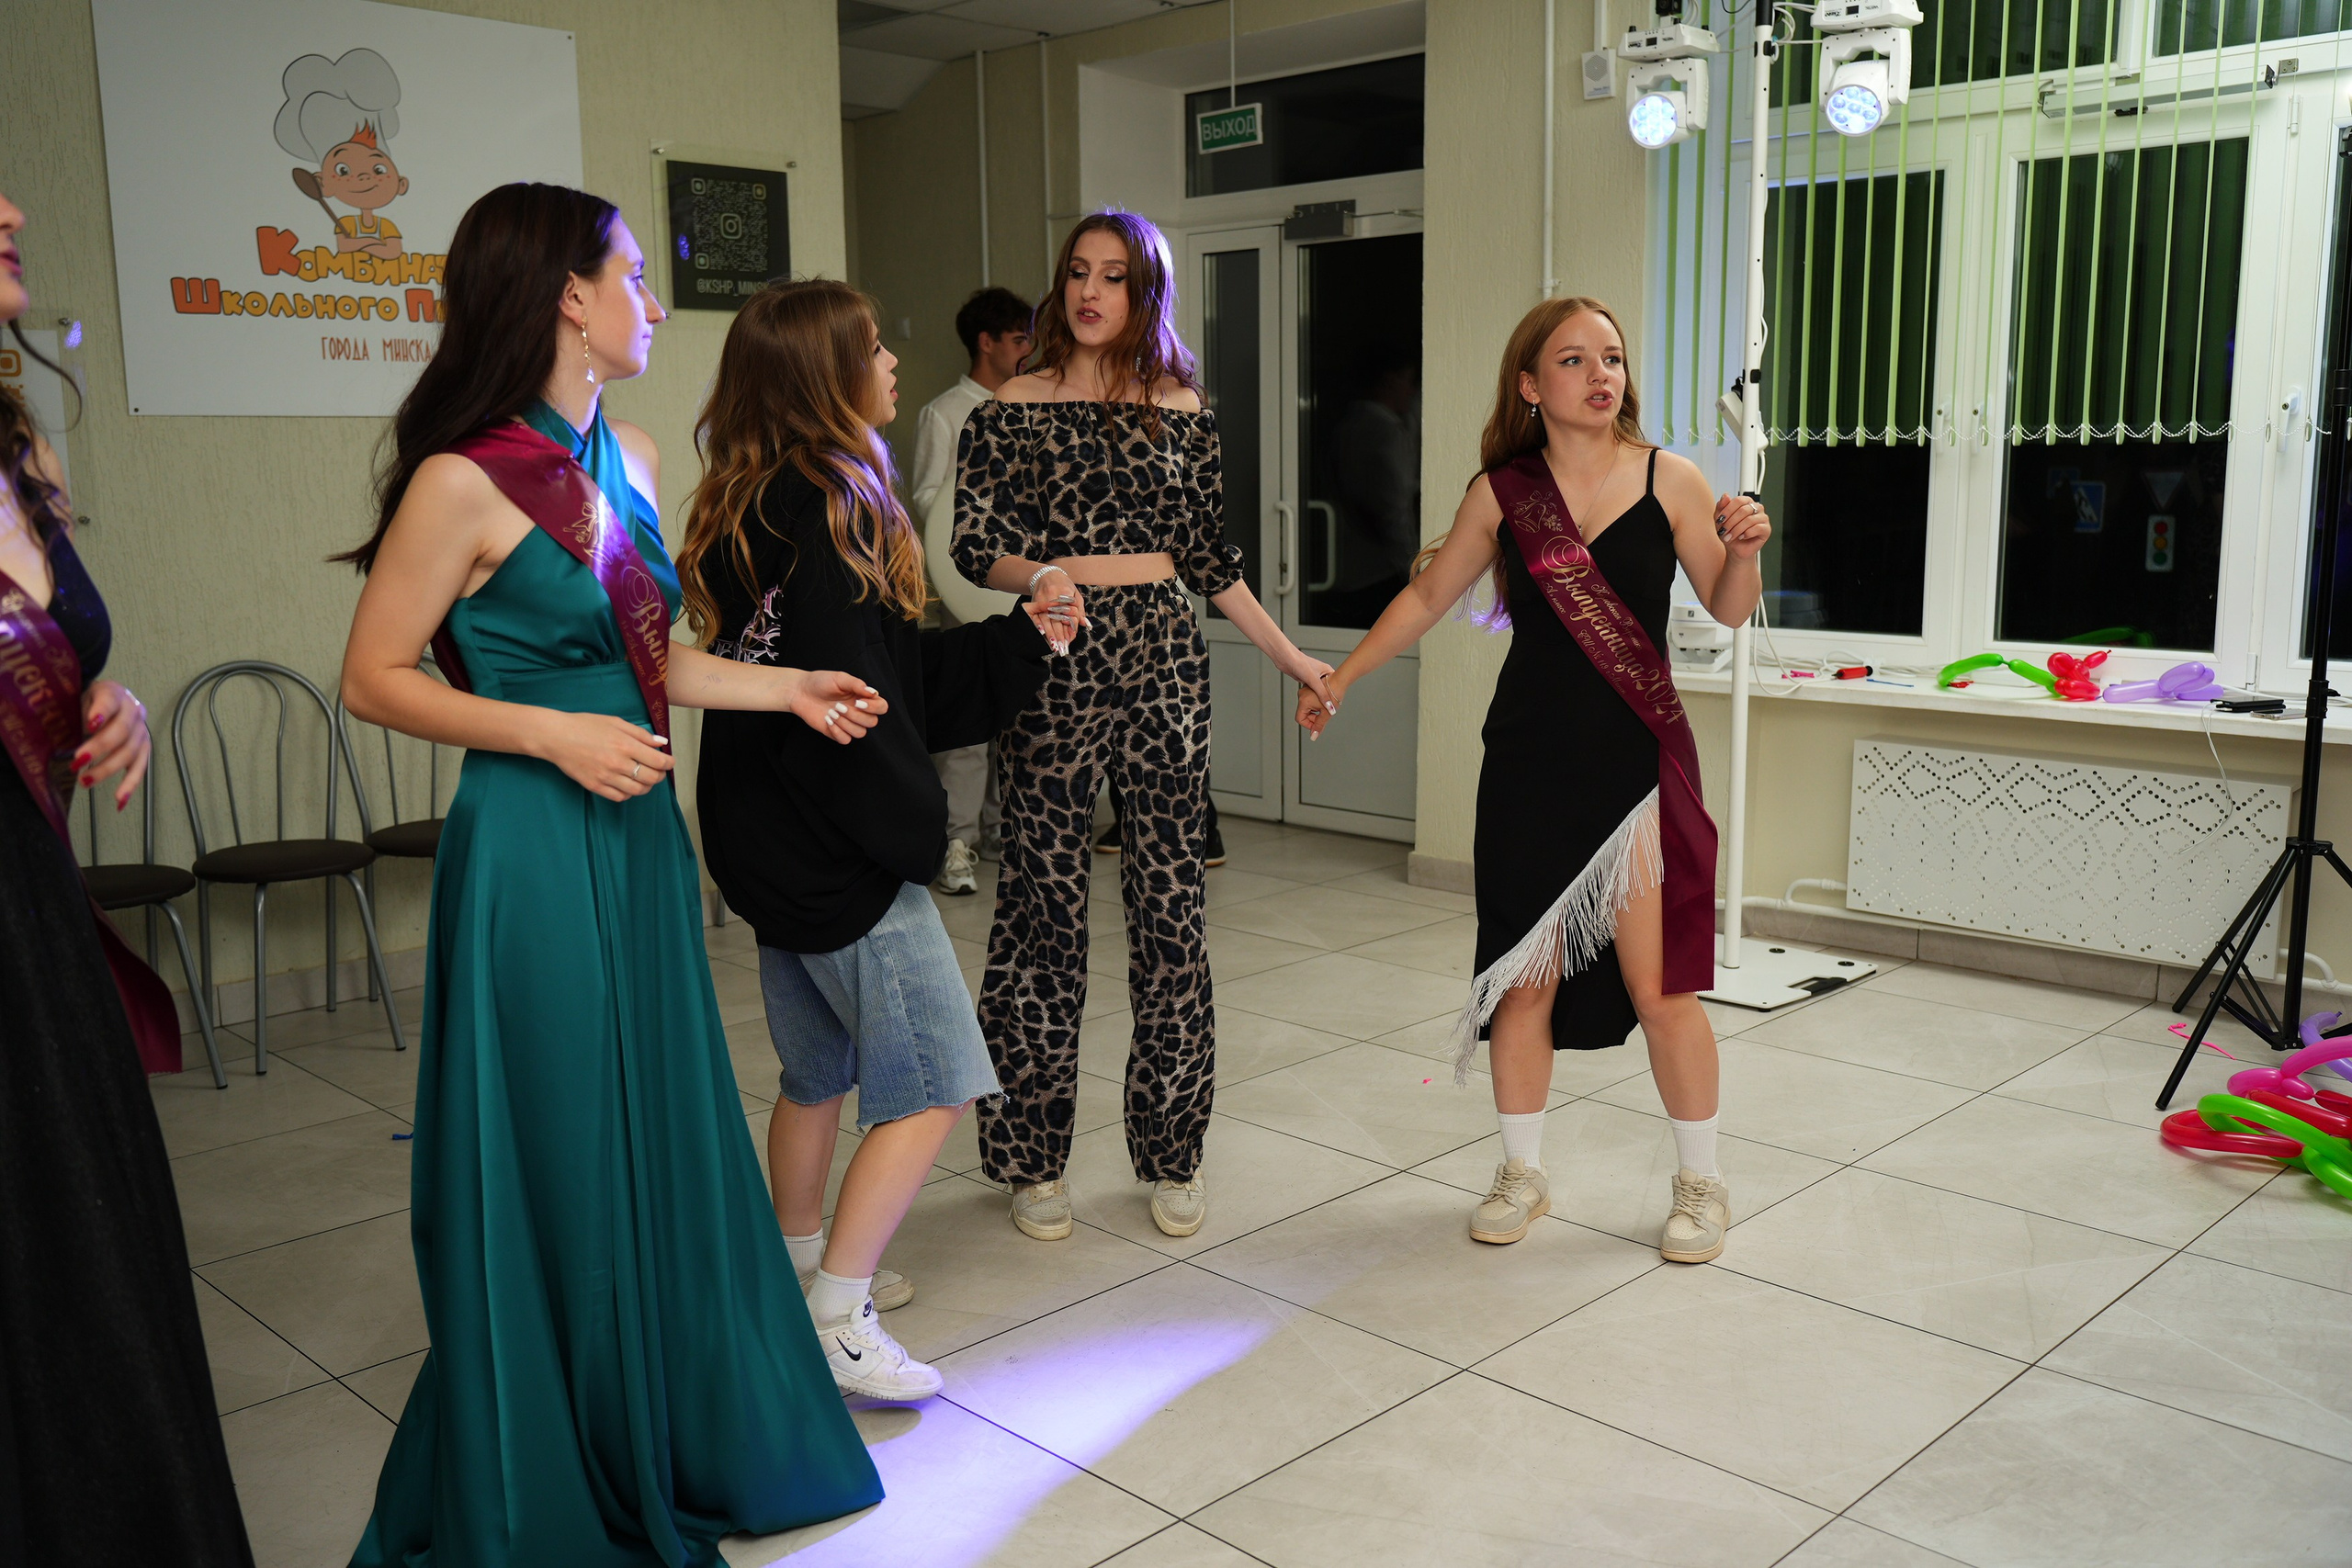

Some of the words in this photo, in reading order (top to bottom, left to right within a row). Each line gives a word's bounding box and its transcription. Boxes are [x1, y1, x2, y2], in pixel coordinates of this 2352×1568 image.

[1202, 115, 1257, 141] ВЫХОД
[322, 336, 369, 361] ГОРОДА
[1542, 536, 1645, 678] Выпускница
[1634, 669, 1684, 725] 2024
